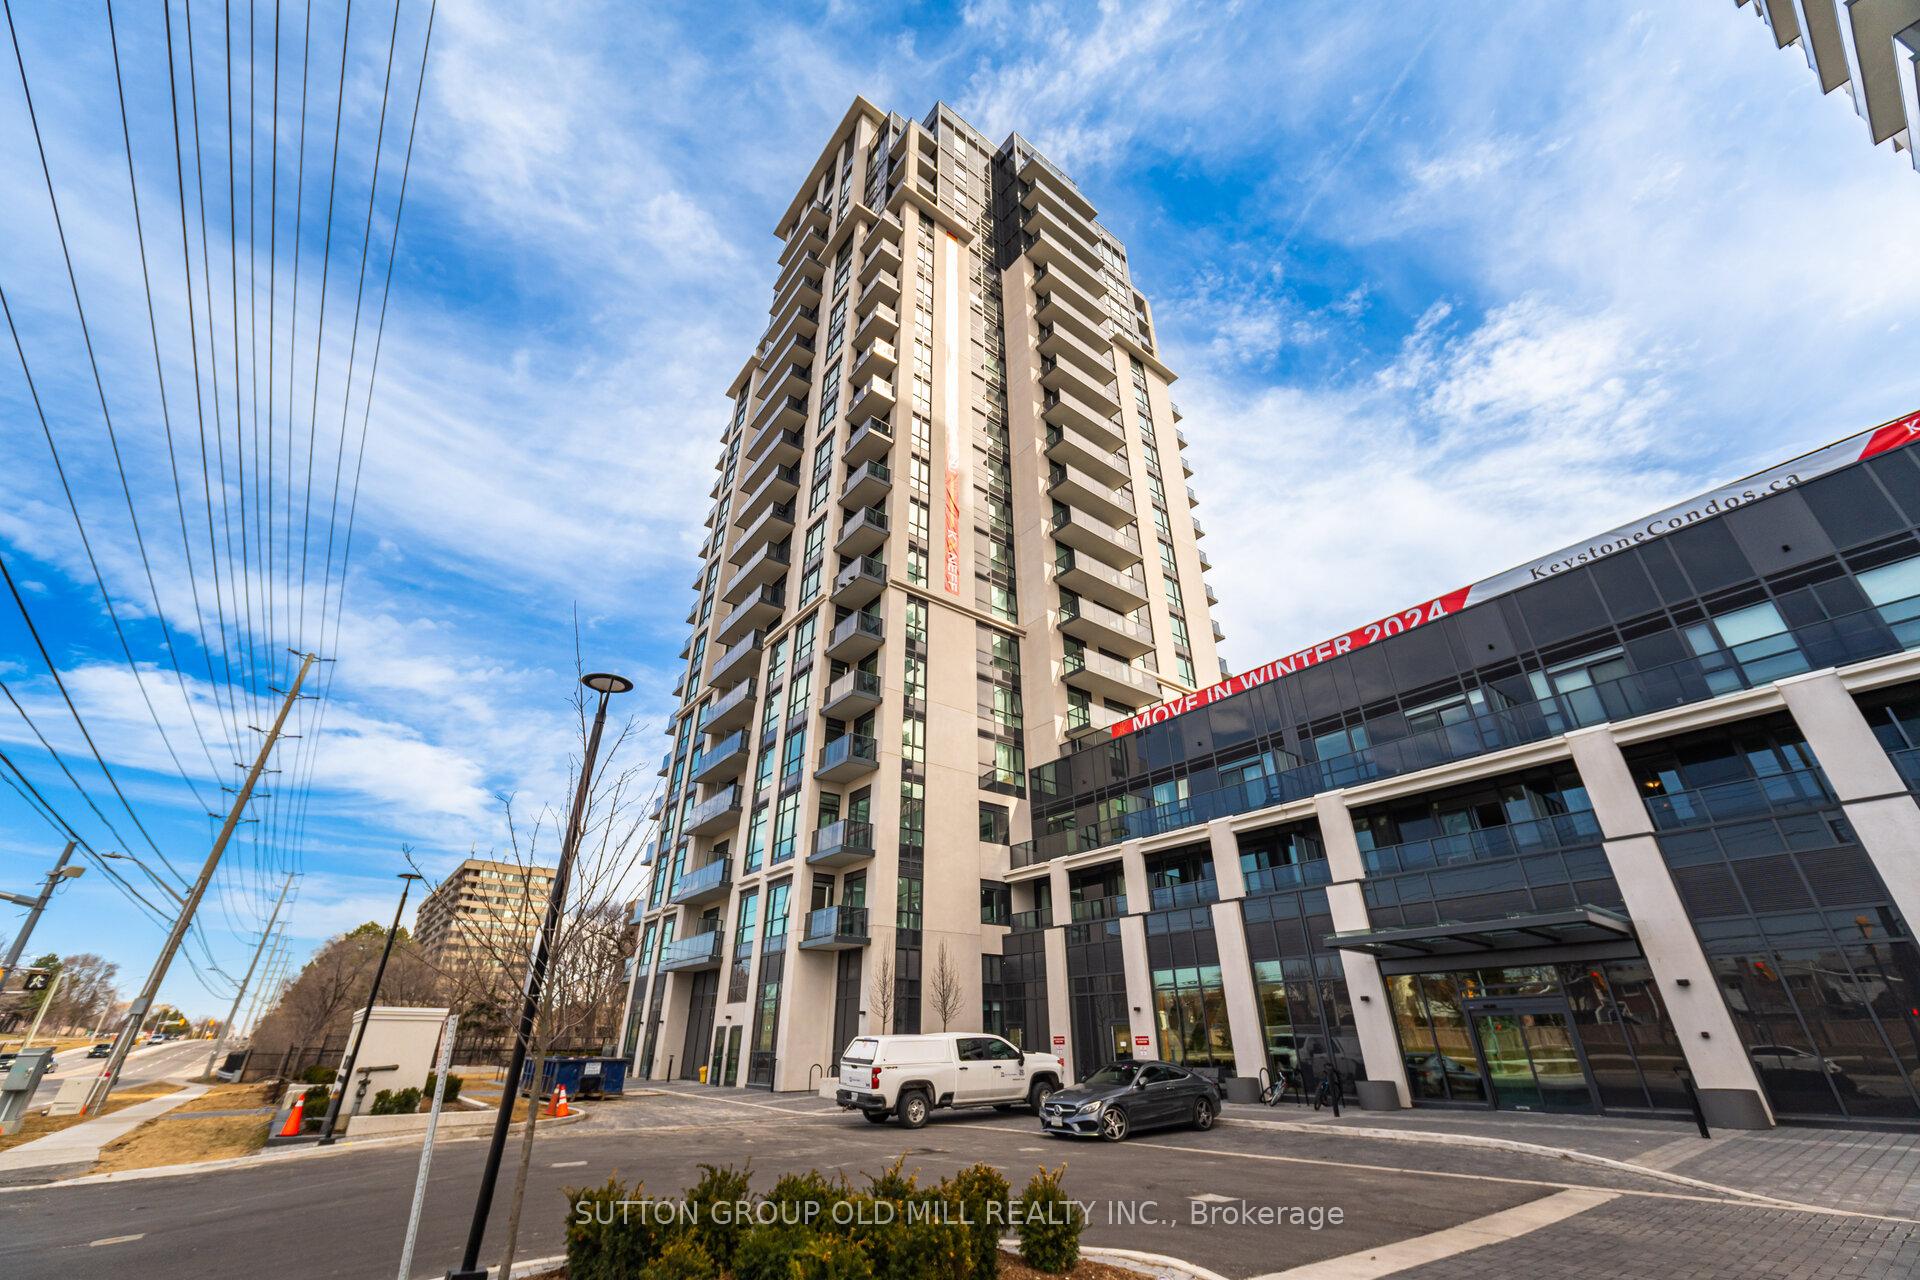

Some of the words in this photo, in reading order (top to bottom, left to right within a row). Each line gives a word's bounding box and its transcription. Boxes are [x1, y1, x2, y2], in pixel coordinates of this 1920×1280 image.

[1529, 472, 1802, 580] KeystoneCondos.ca
[1132, 693, 1198, 731] MOVE
[1207, 681, 1233, 703] IN
[1240, 635, 1352, 689] WINTER
[1365, 599, 1448, 644] 2024
